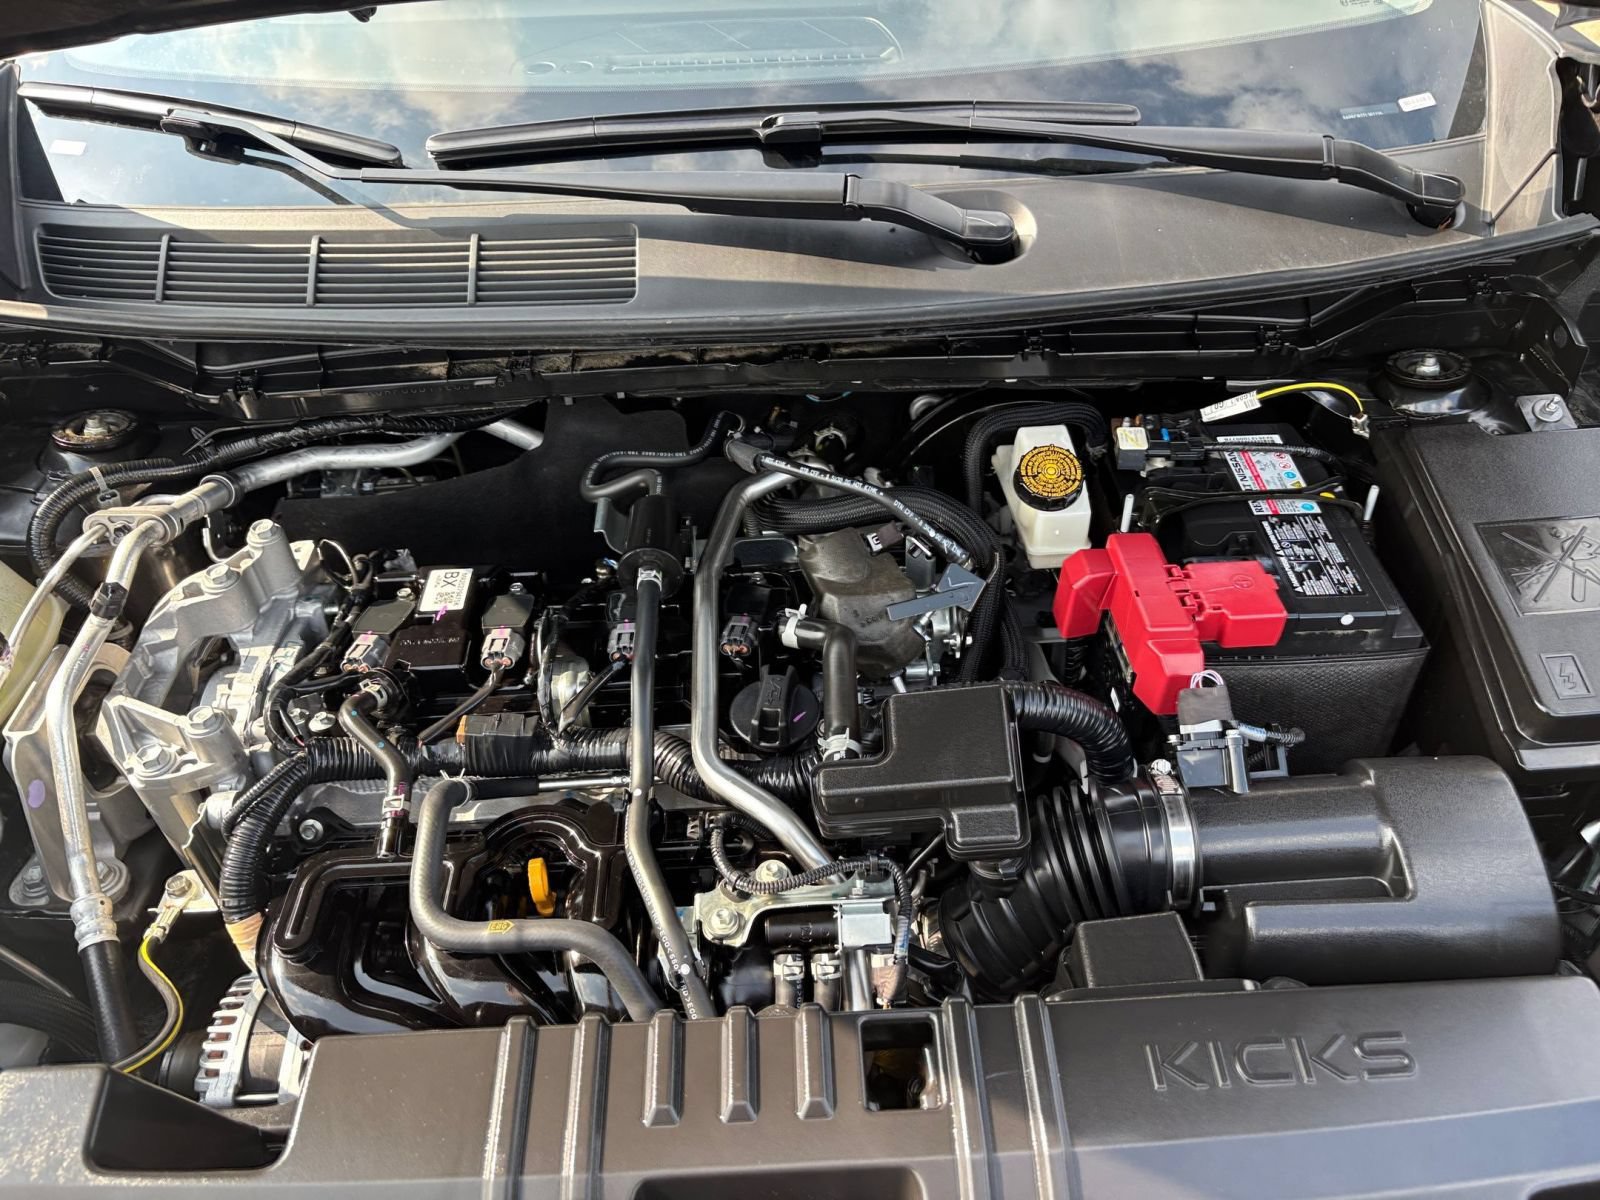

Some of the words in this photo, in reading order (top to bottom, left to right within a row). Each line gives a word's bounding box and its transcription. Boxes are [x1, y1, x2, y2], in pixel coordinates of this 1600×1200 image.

[1227, 450, 1249, 482] NISSAN
[441, 571, 460, 588] BX
[1144, 1031, 1417, 1091] KICKS
